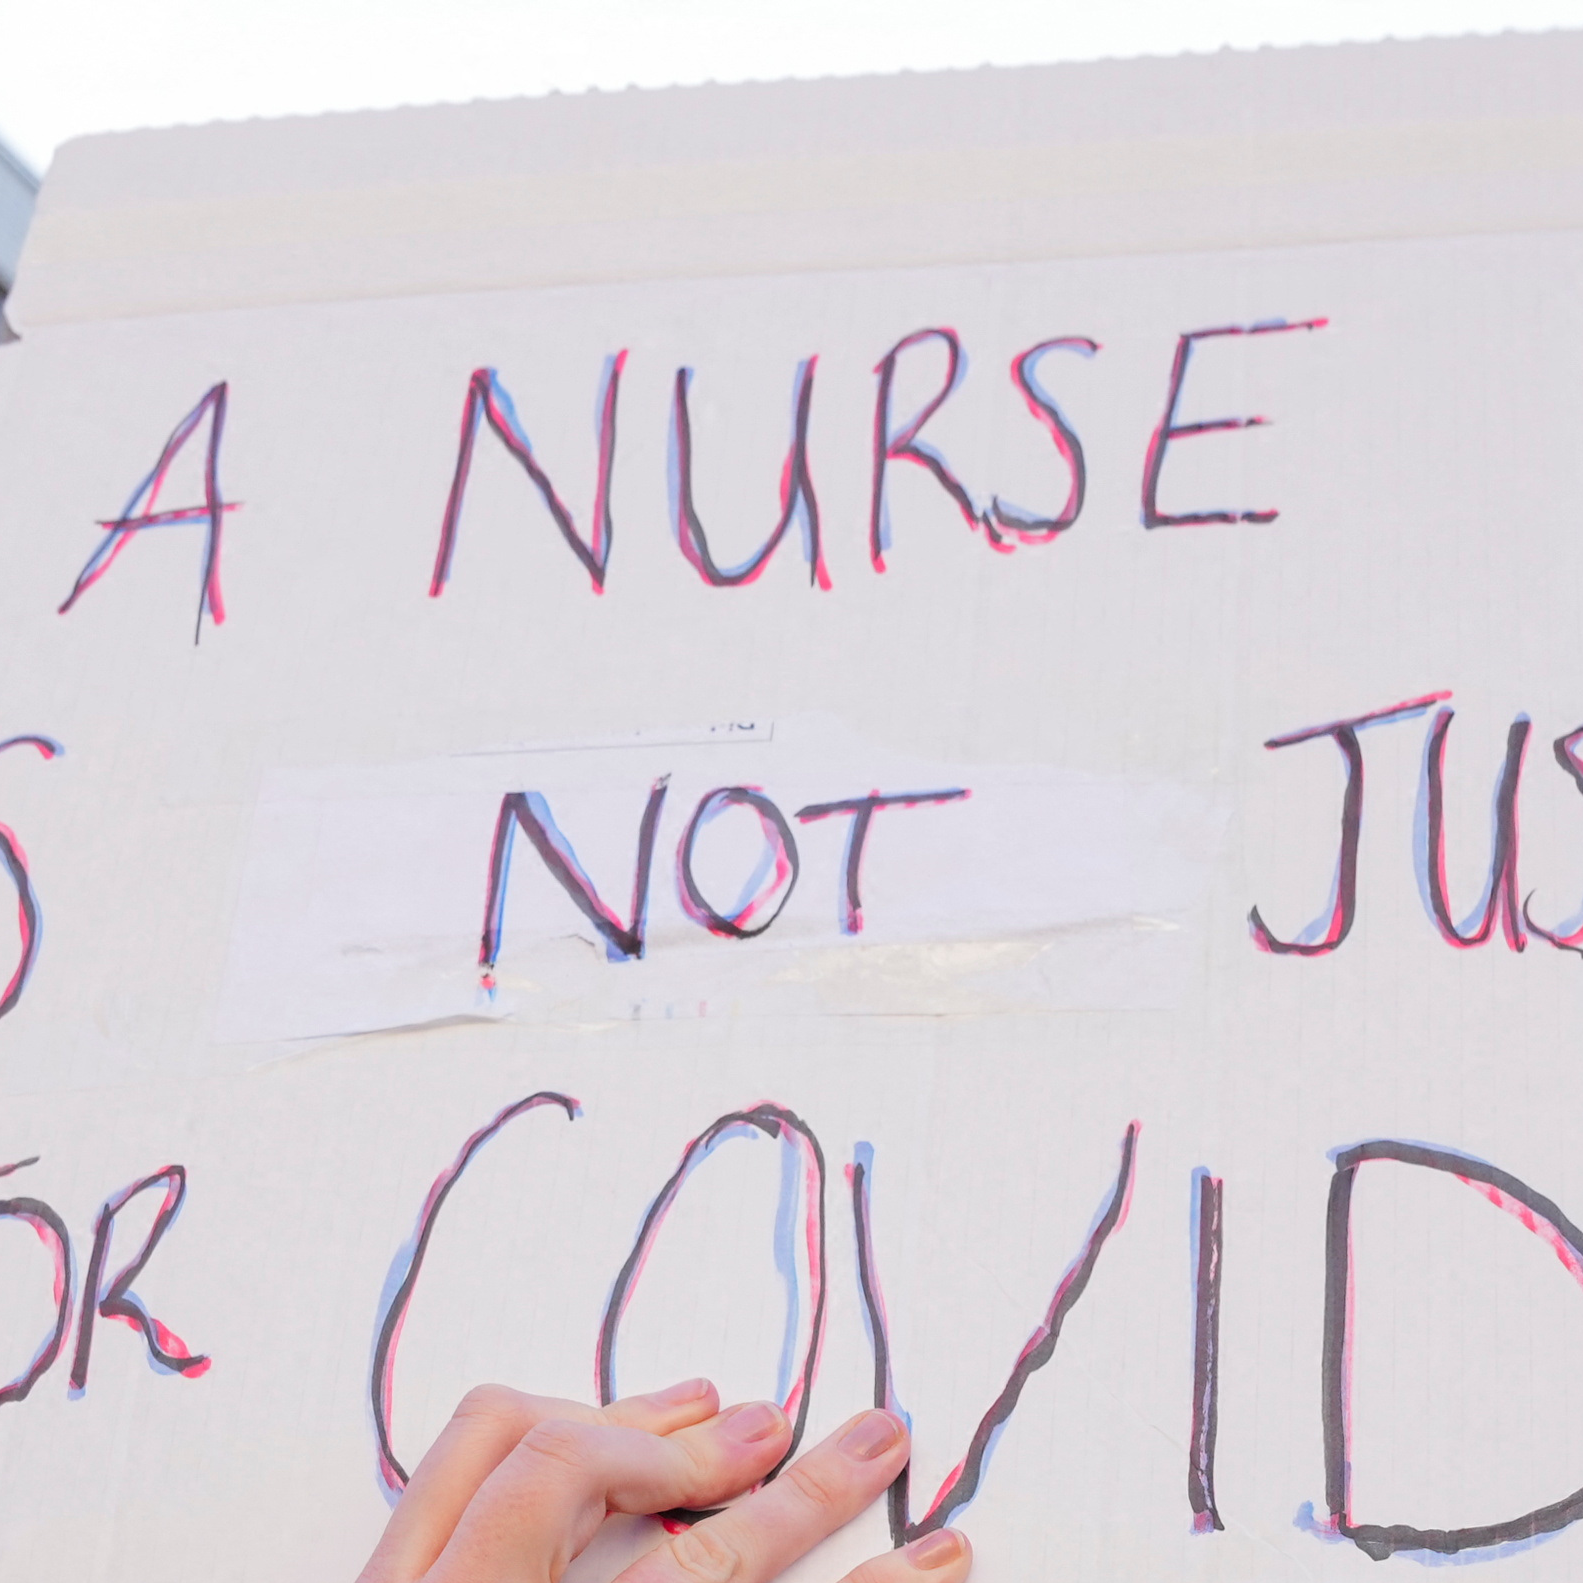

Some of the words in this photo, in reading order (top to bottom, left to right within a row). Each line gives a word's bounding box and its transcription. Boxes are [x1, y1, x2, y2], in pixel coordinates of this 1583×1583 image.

[58, 380, 245, 647] A
[428, 316, 1331, 598] NURSE
[474, 771, 974, 1005] NOT
